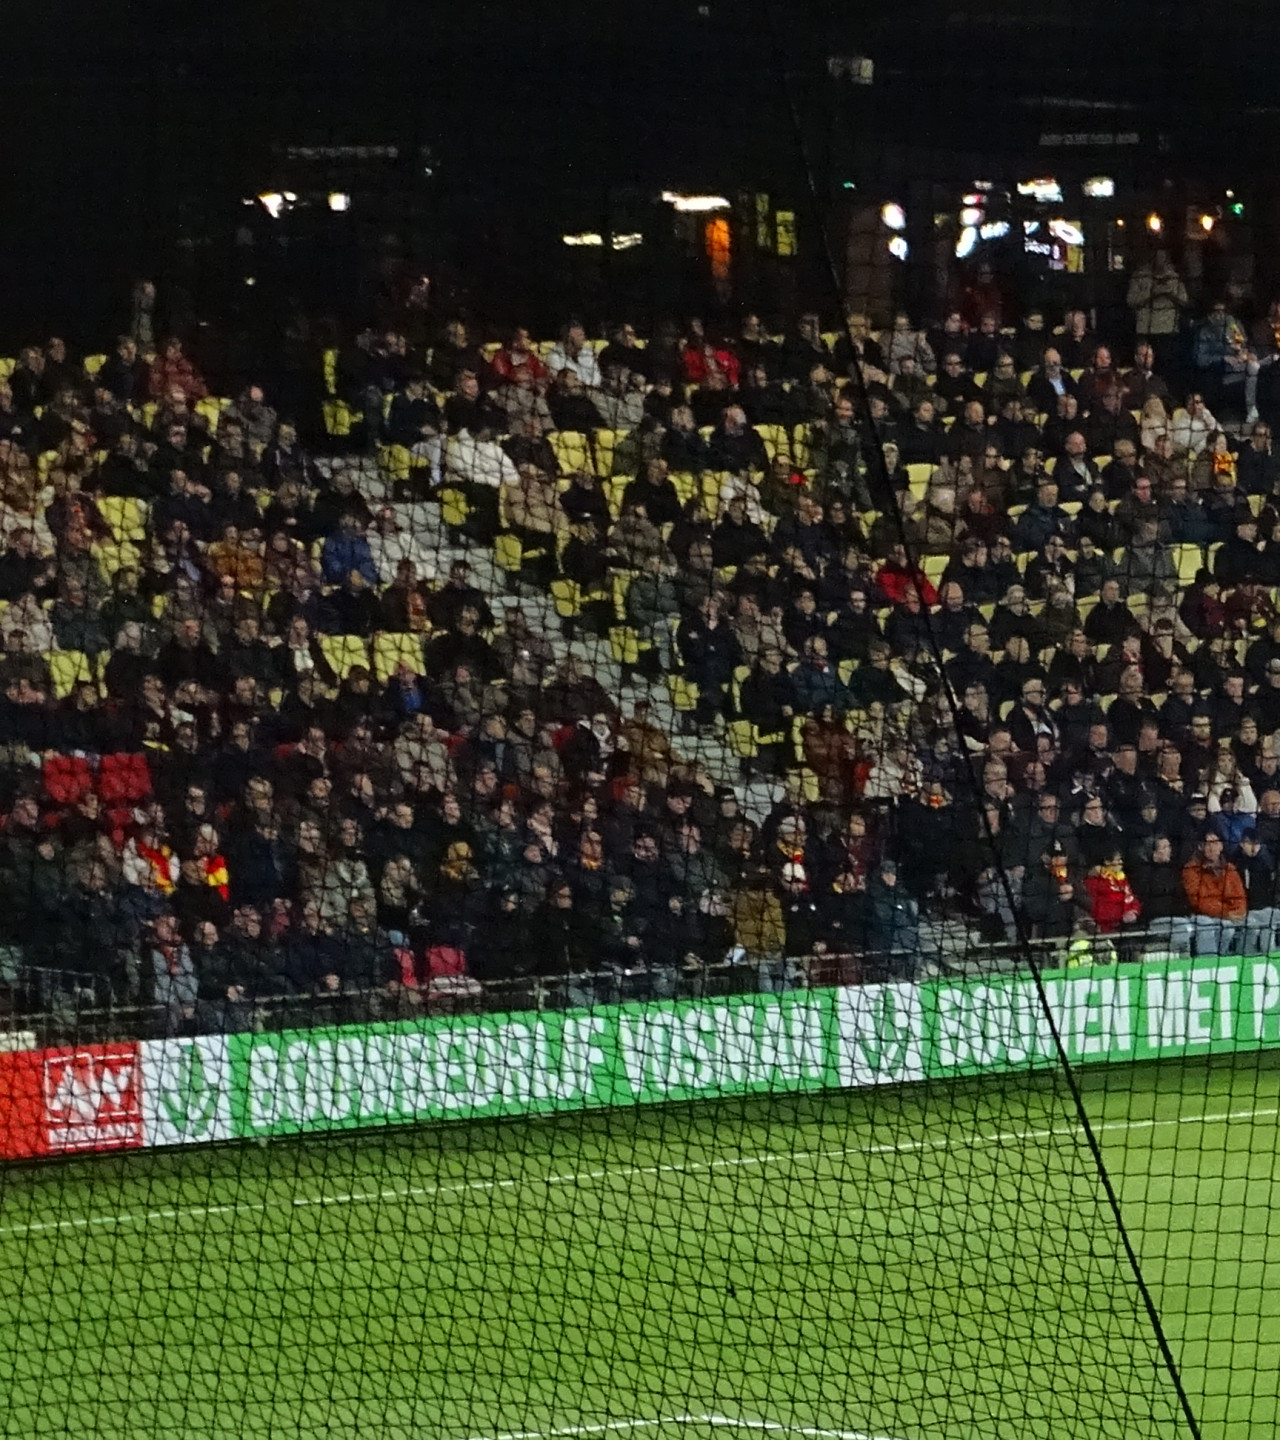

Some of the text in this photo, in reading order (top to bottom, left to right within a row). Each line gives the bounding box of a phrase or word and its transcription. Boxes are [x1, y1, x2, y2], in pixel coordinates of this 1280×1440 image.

[250, 1000, 823, 1127] BOUWBEDRIJF VOSMAN
[939, 976, 1131, 1066] BOUWEN
[1146, 965, 1237, 1048] MET
